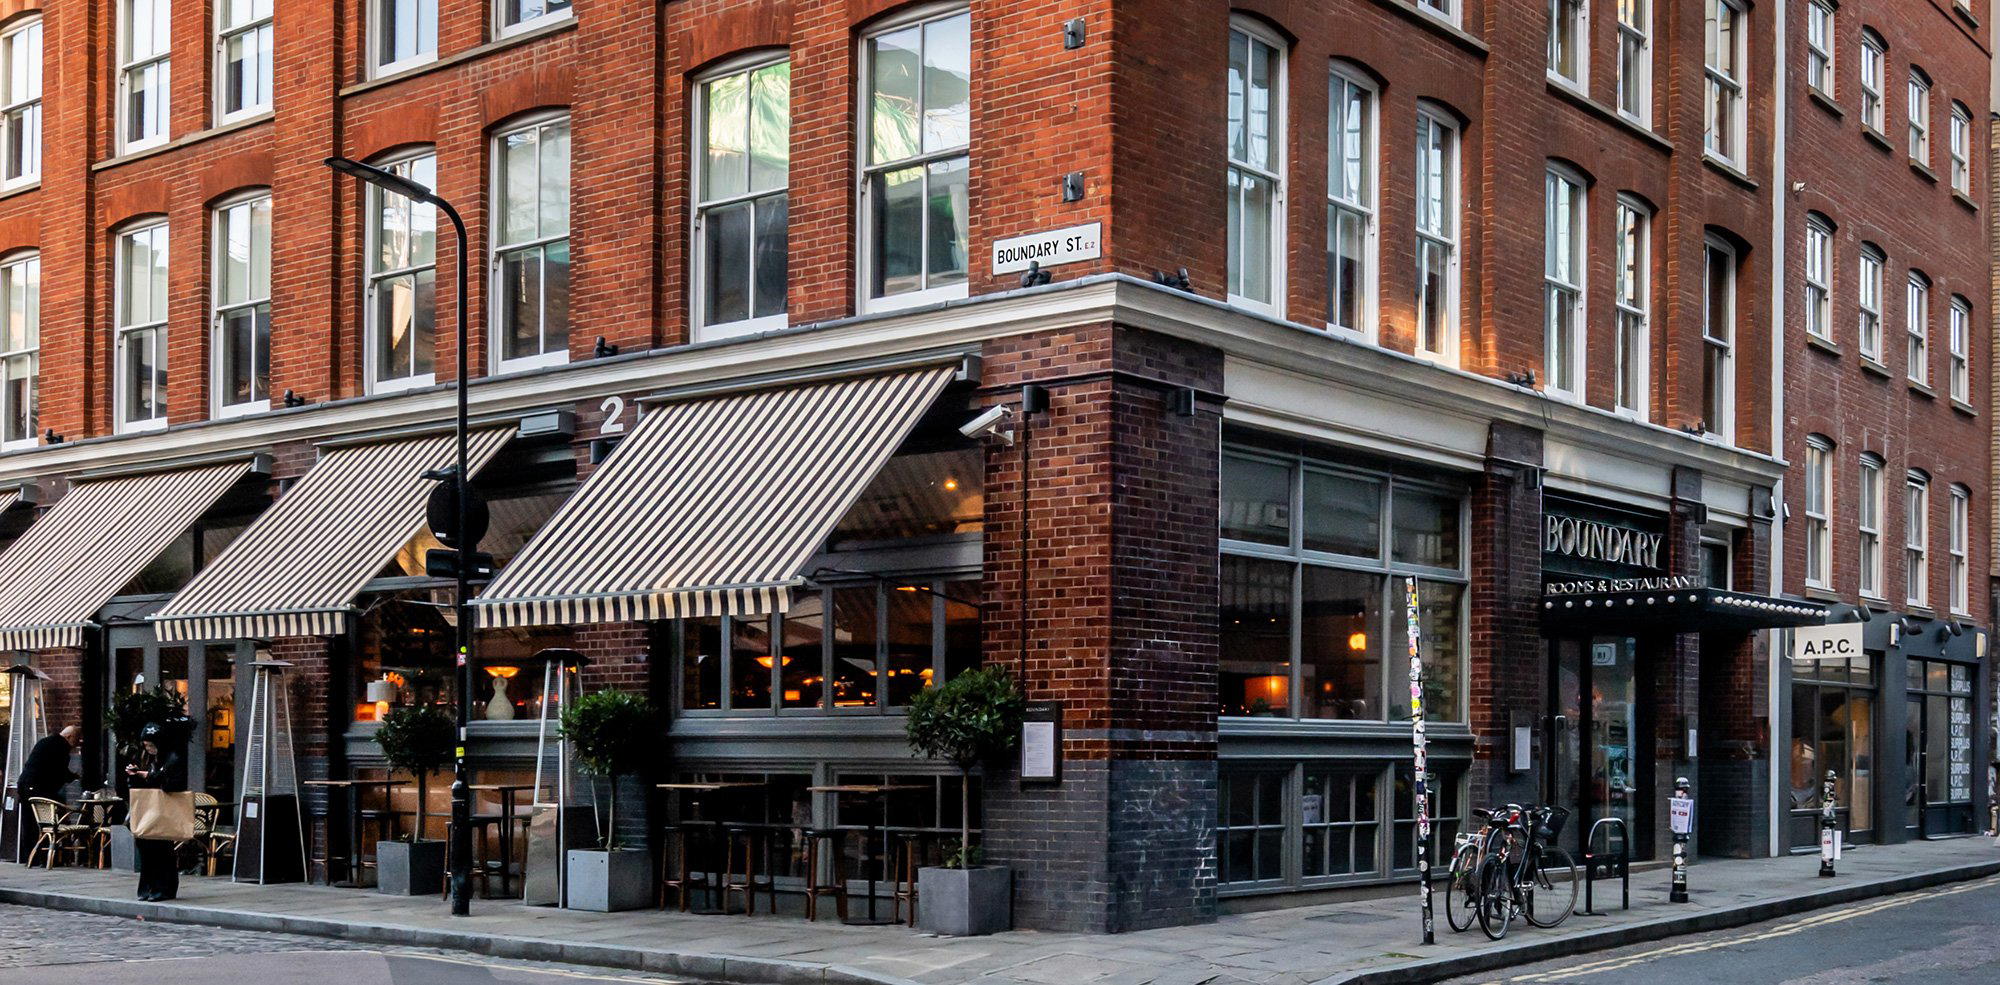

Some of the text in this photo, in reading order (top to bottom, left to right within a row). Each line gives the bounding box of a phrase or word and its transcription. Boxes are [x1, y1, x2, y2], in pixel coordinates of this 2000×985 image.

[997, 240, 1060, 264] BOUNDARY
[1066, 236, 1082, 252] ST.
[600, 395, 624, 435] 2
[1545, 514, 1664, 570] BOUNDARY
[1546, 580, 1594, 595] ROOMS
[1597, 580, 1607, 592] &
[1803, 638, 1855, 655] A.P.C.
